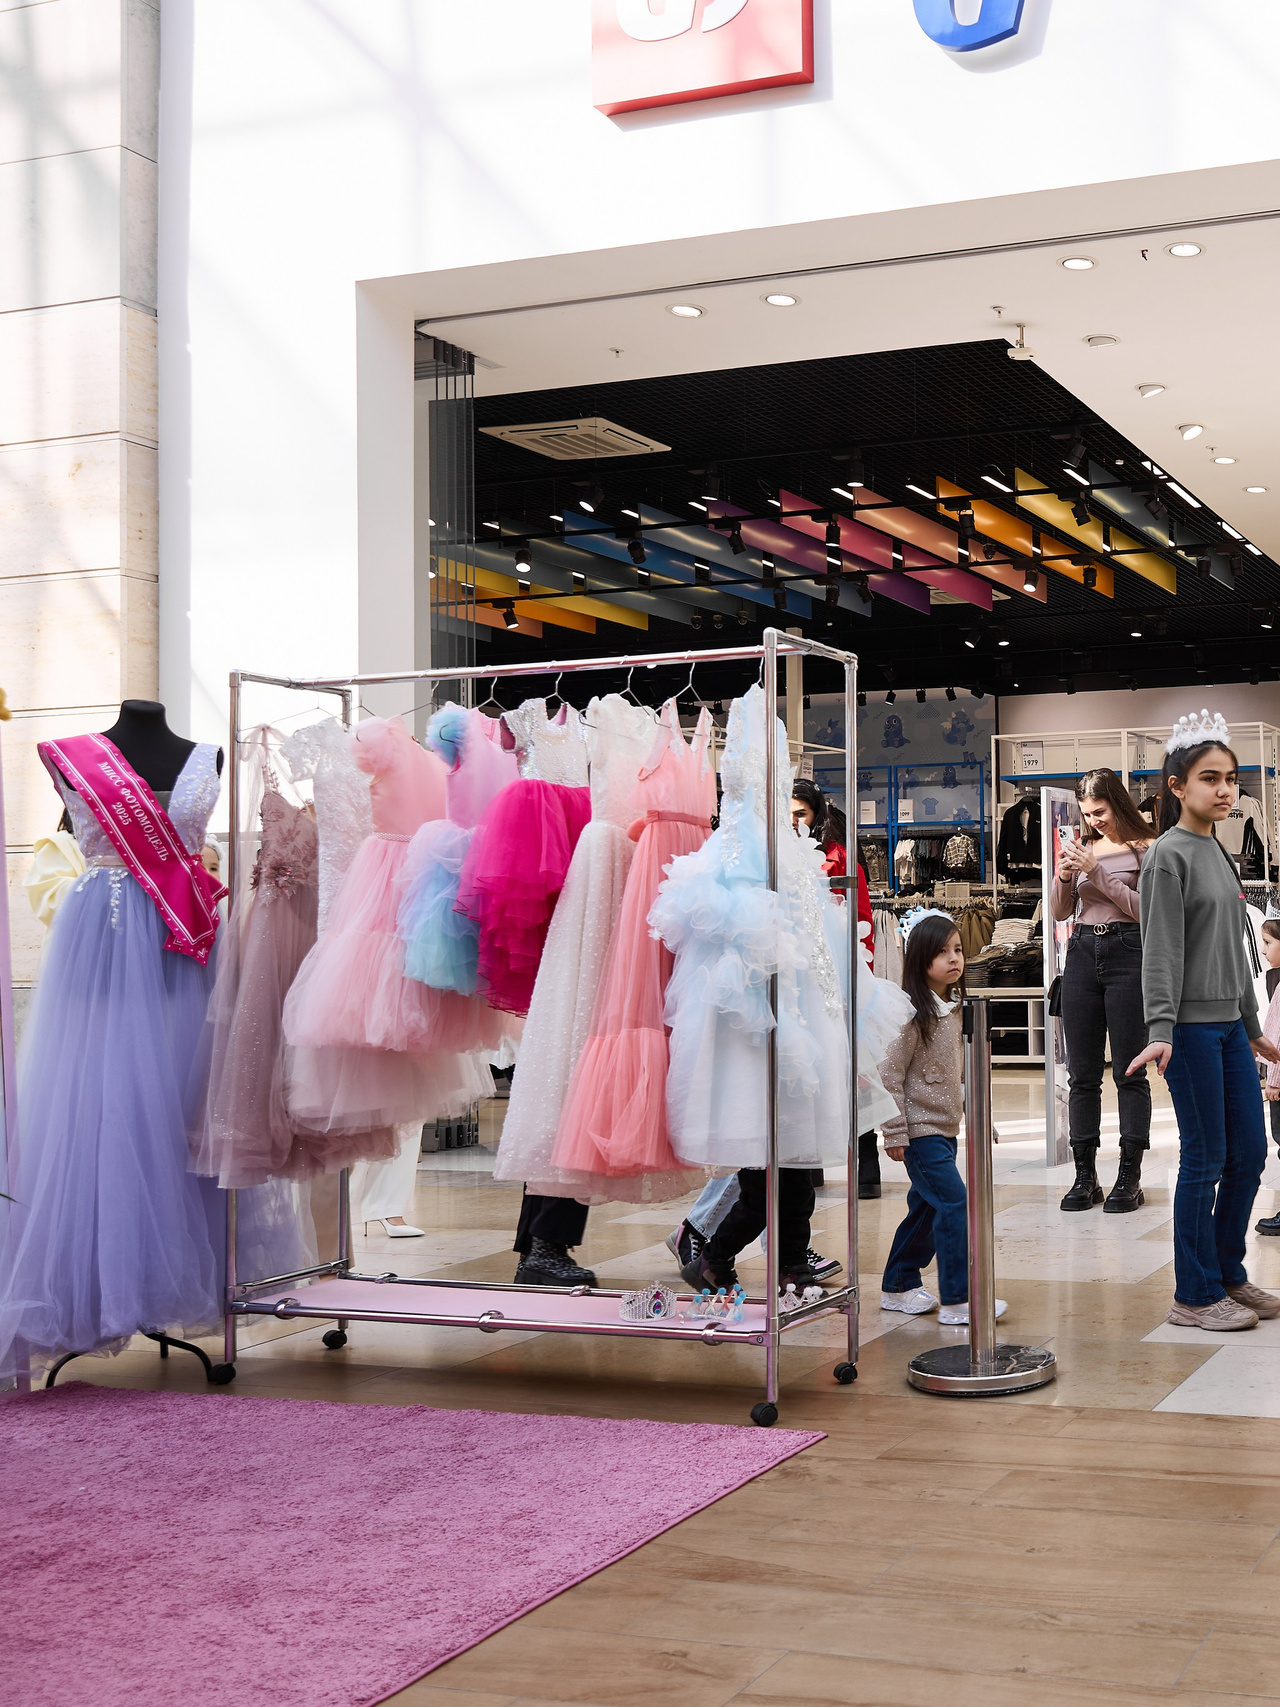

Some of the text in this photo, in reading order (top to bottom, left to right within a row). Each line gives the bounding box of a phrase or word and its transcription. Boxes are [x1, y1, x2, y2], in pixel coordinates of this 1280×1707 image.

[1023, 759, 1039, 767] 1979
[98, 761, 171, 862] МИСС ФОТОМОДЕЛЬ
[112, 802, 133, 826] 2025
